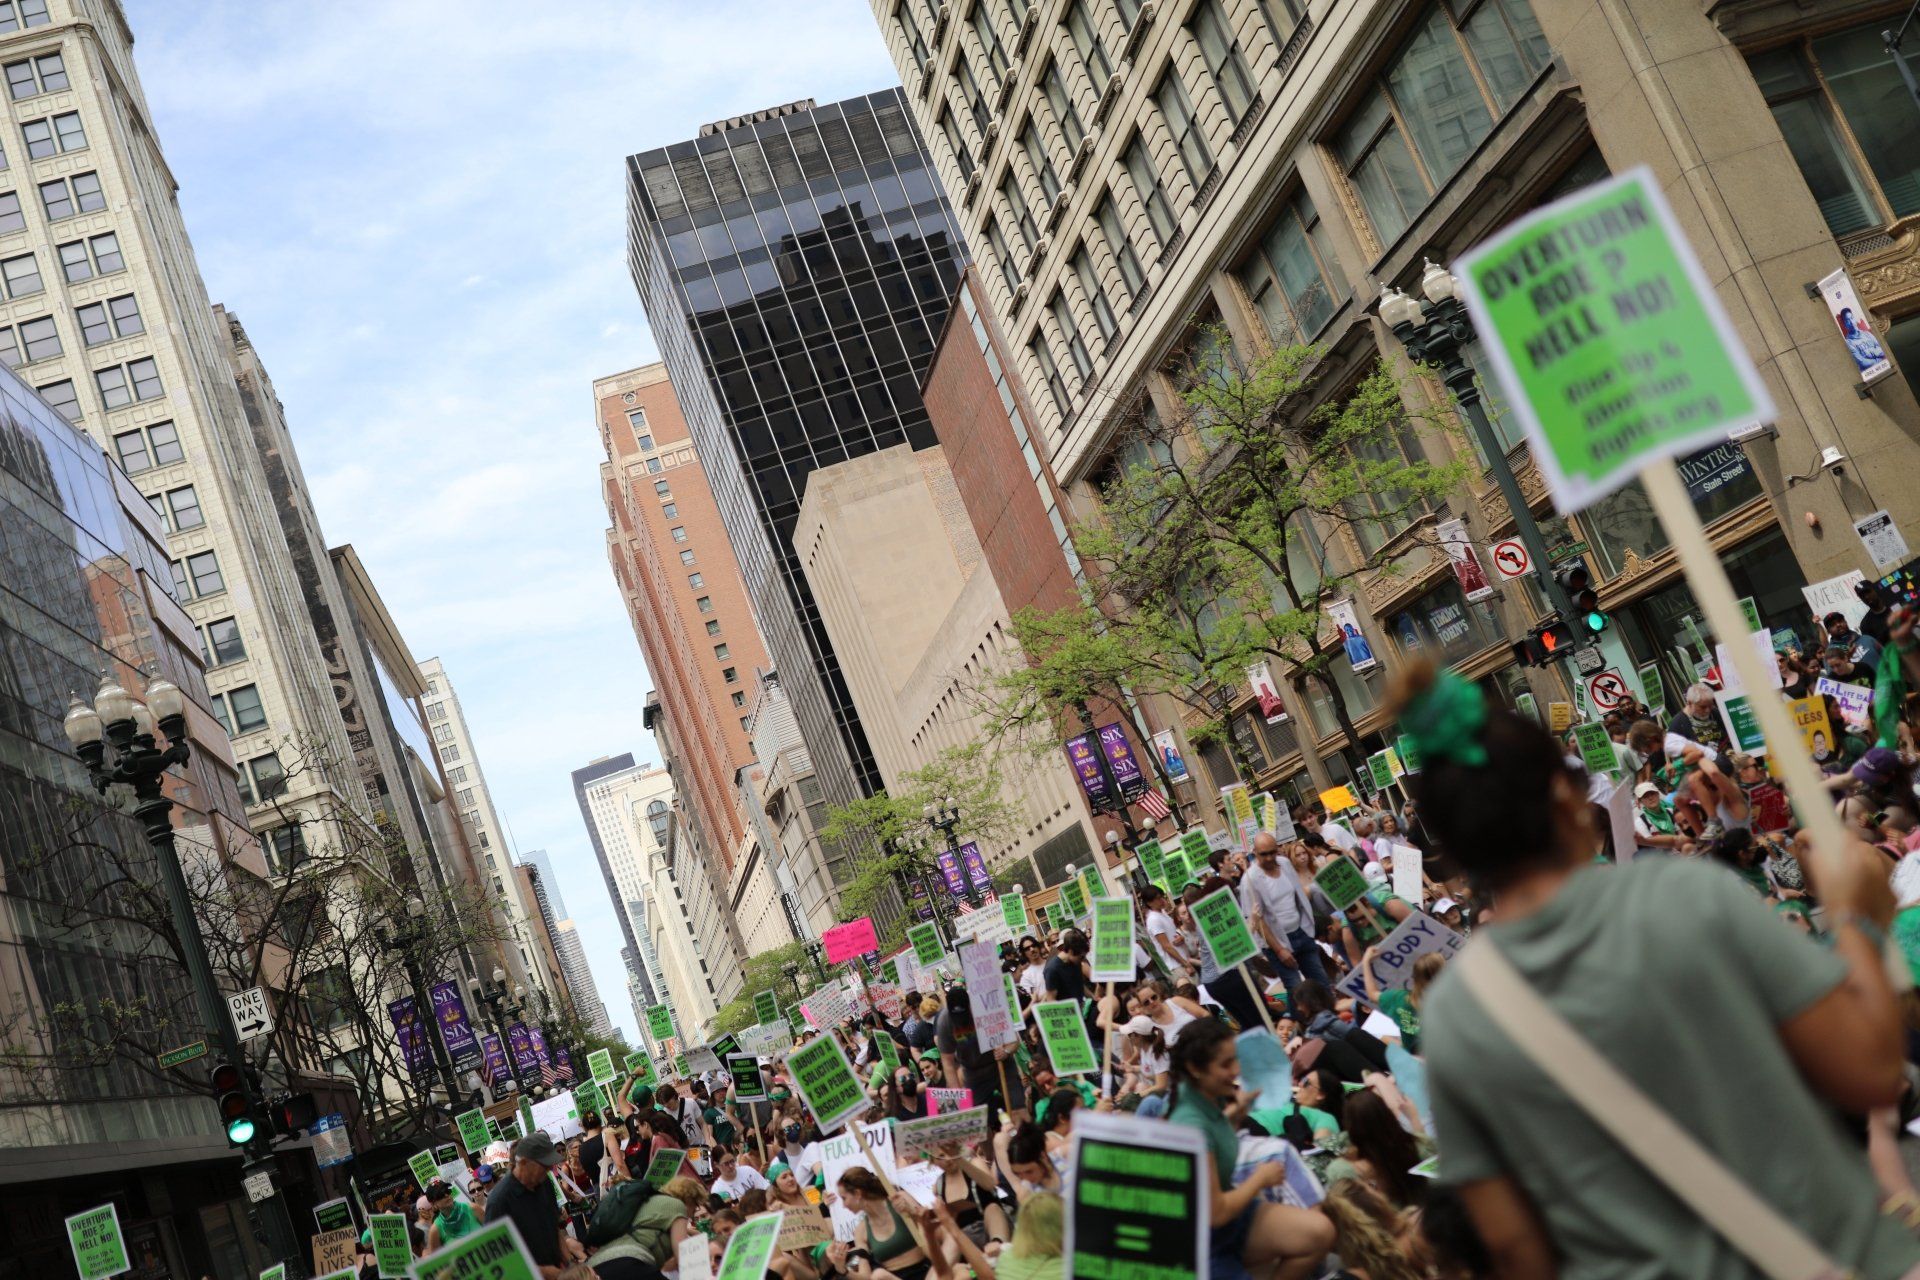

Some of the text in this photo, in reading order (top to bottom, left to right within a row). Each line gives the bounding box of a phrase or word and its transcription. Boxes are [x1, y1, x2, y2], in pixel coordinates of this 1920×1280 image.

[1481, 197, 1649, 300] OVERTURN
[1677, 440, 1743, 484] WINTRUS
[1702, 463, 1745, 493] State Street
[1429, 603, 1461, 632] JIMMY
[1438, 619, 1469, 647] JOHN'S
[1101, 727, 1124, 744] SIX
[1114, 757, 1137, 774] SIX
[1381, 919, 1435, 968] BODY
[233, 991, 261, 1010] ONE
[434, 987, 458, 1005] SIX
[235, 1003, 264, 1022] WAY
[445, 1021, 469, 1040] SIX
[814, 1083, 829, 1098] SIN
[931, 1090, 966, 1098] SHAME
[825, 1137, 854, 1161] FUCK
[252, 1191, 262, 1199] OK
[71, 1211, 113, 1232] OVERTURN
[372, 1219, 404, 1230] OVERTURN
[79, 1232, 115, 1251] HELL NO!
[82, 1227, 98, 1239] ROE
[380, 1230, 394, 1238] ROE
[323, 1244, 344, 1259] SAVE
[378, 1240, 394, 1249] HELL
[320, 1255, 355, 1276] LIVES
